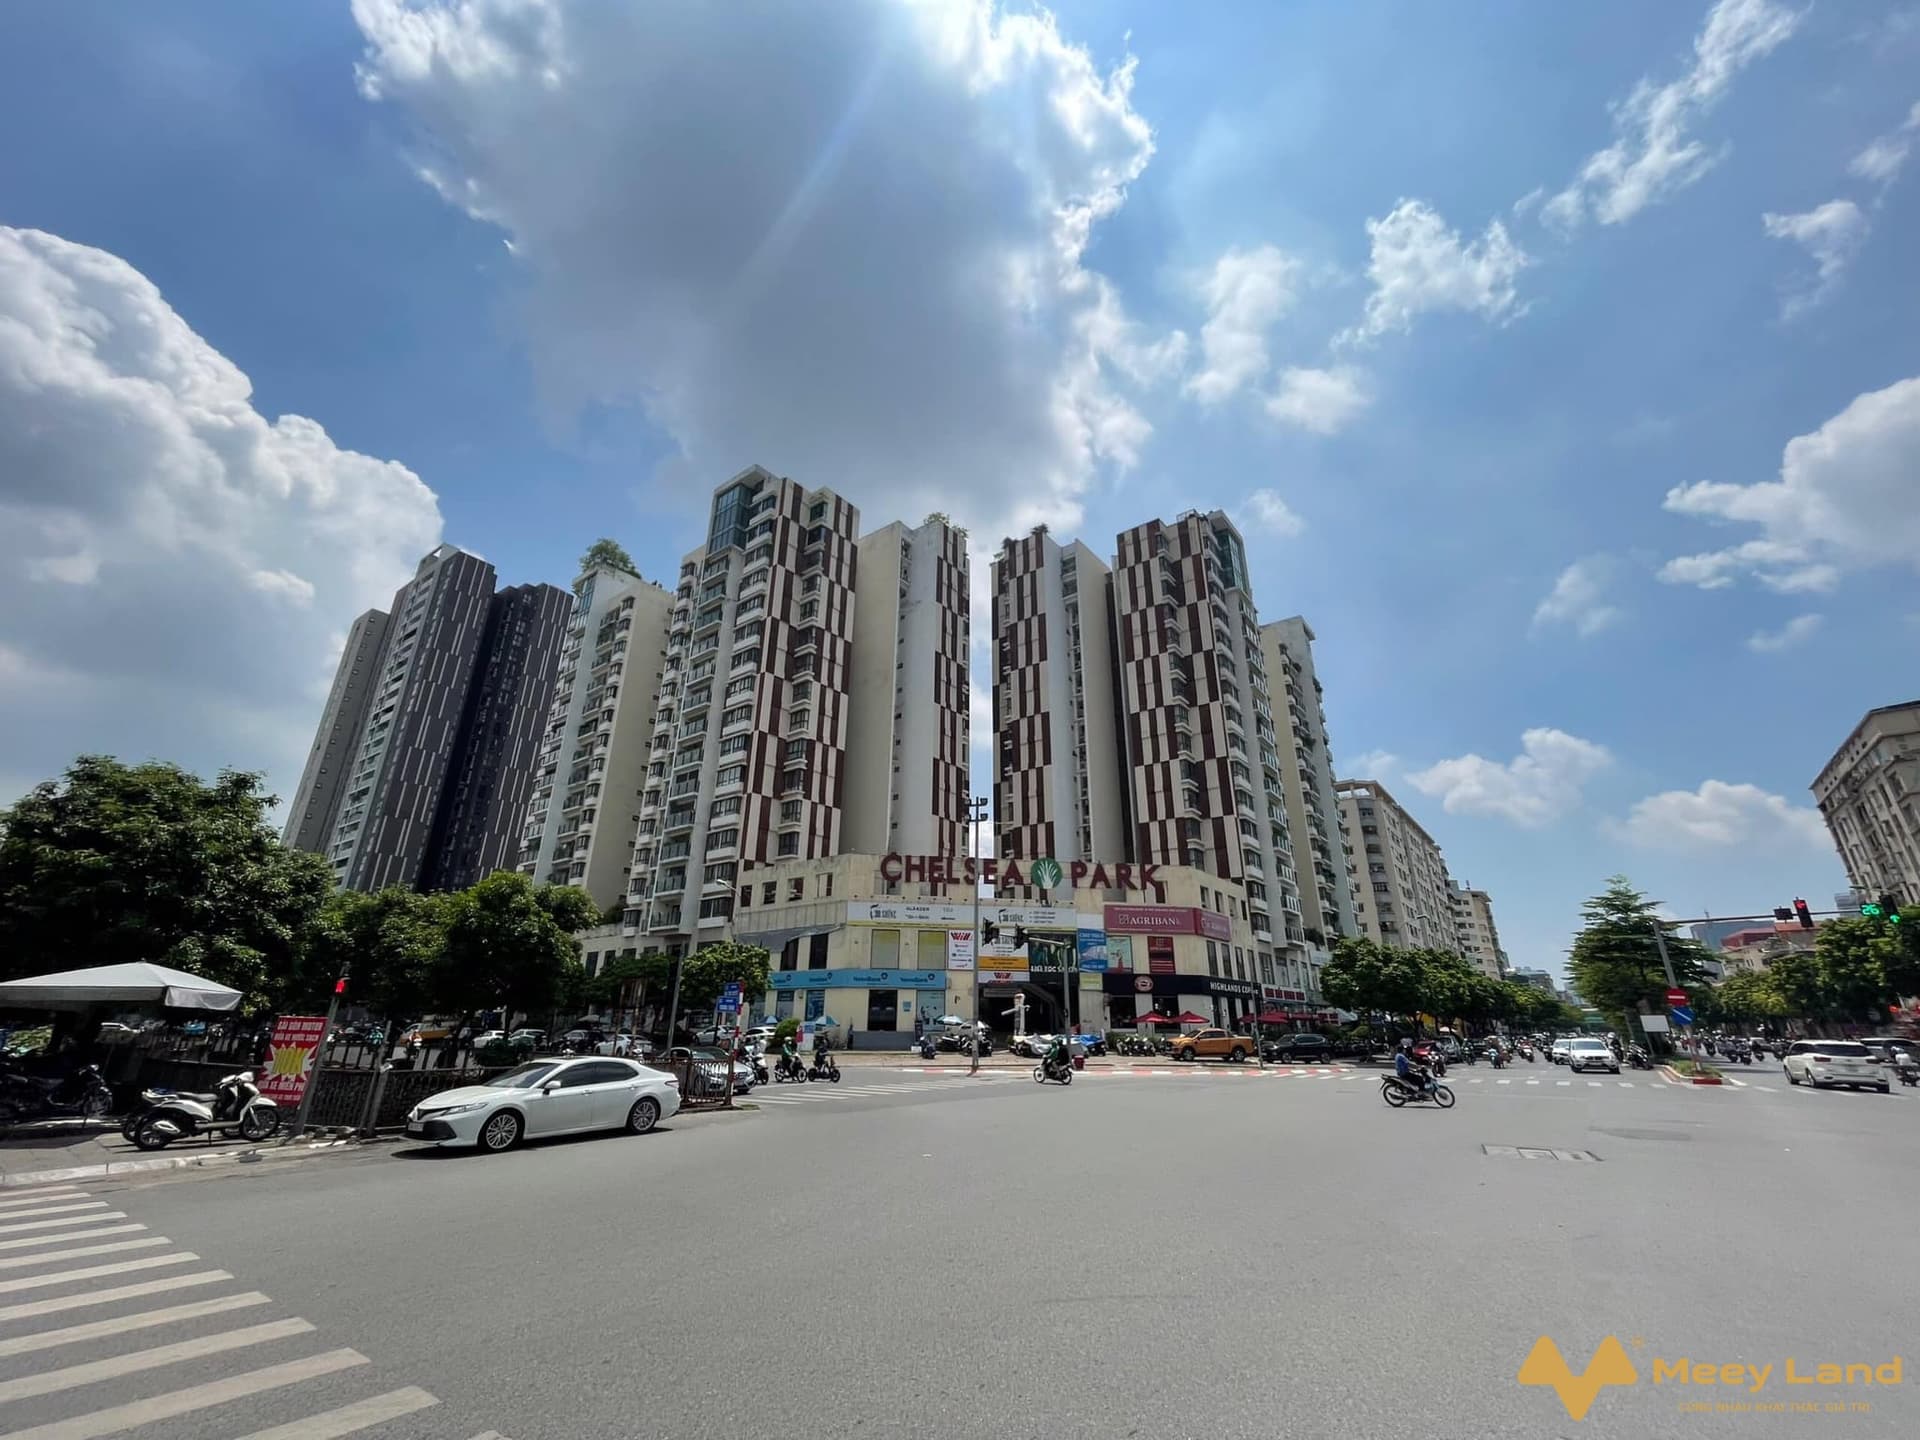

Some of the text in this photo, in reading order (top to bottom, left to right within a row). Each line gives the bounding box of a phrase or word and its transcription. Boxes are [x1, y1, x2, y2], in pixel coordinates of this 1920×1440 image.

[880, 852, 1162, 889] CHELSEA PARK
[1861, 904, 1880, 915] 26
[1209, 981, 1241, 993] HIGHLANDS
[1241, 986, 1259, 995] COFE
